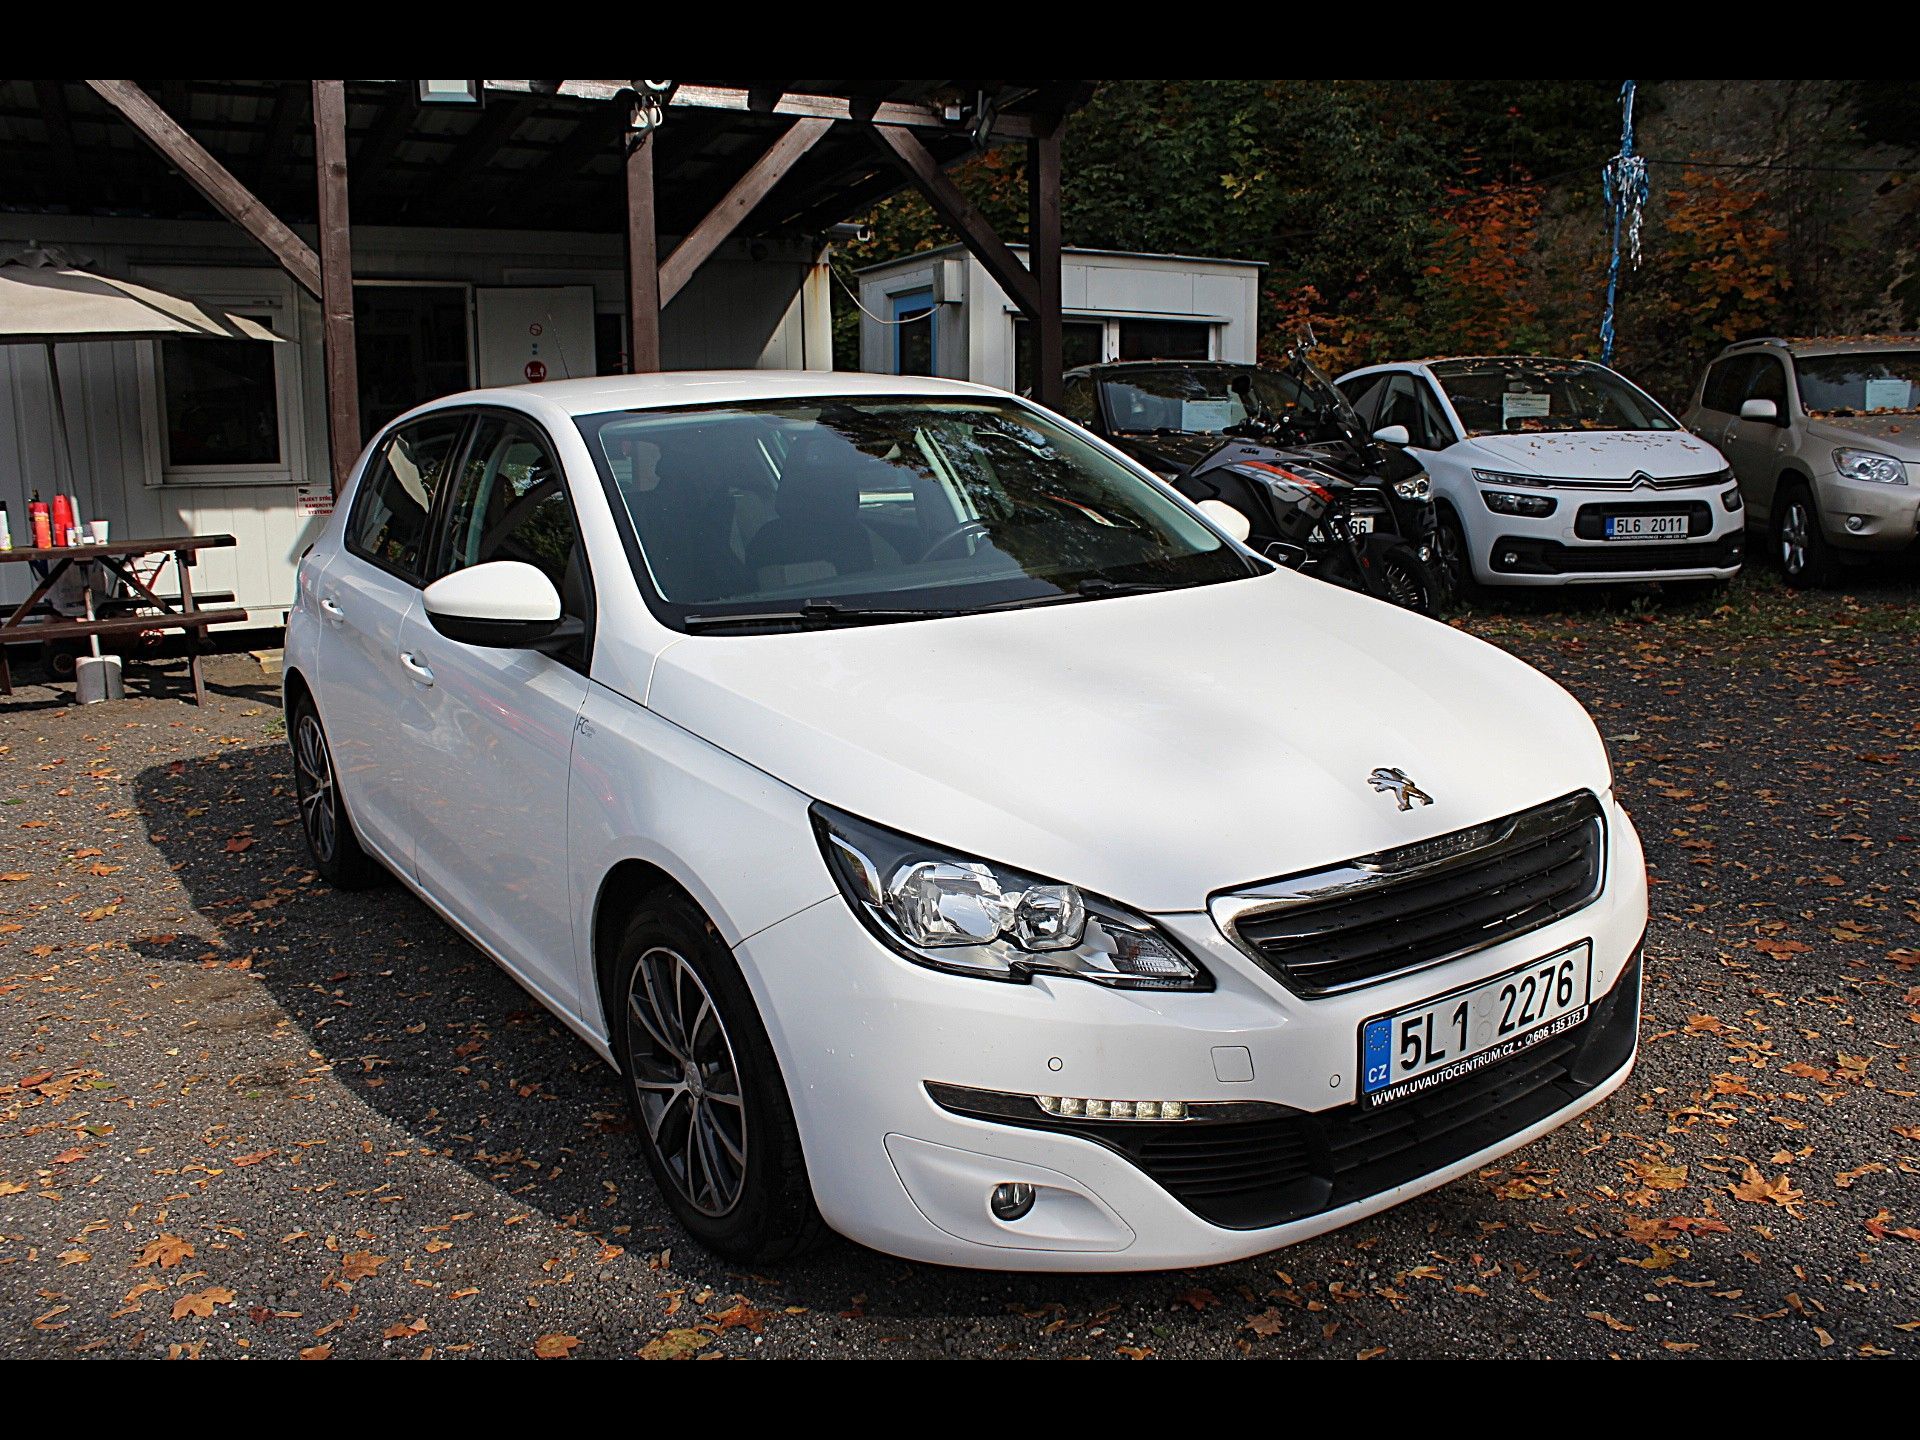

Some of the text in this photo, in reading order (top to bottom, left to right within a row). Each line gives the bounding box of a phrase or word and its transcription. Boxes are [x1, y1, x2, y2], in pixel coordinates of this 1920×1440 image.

[1240, 447, 1260, 456] KTM
[1616, 517, 1684, 534] 5L6 2011
[1400, 959, 1574, 1071] 5L1 2276
[1371, 1011, 1580, 1107] WWW.UVAUTOCENTRUM.CZ 606 135 173
[1368, 1063, 1387, 1083] CZ
